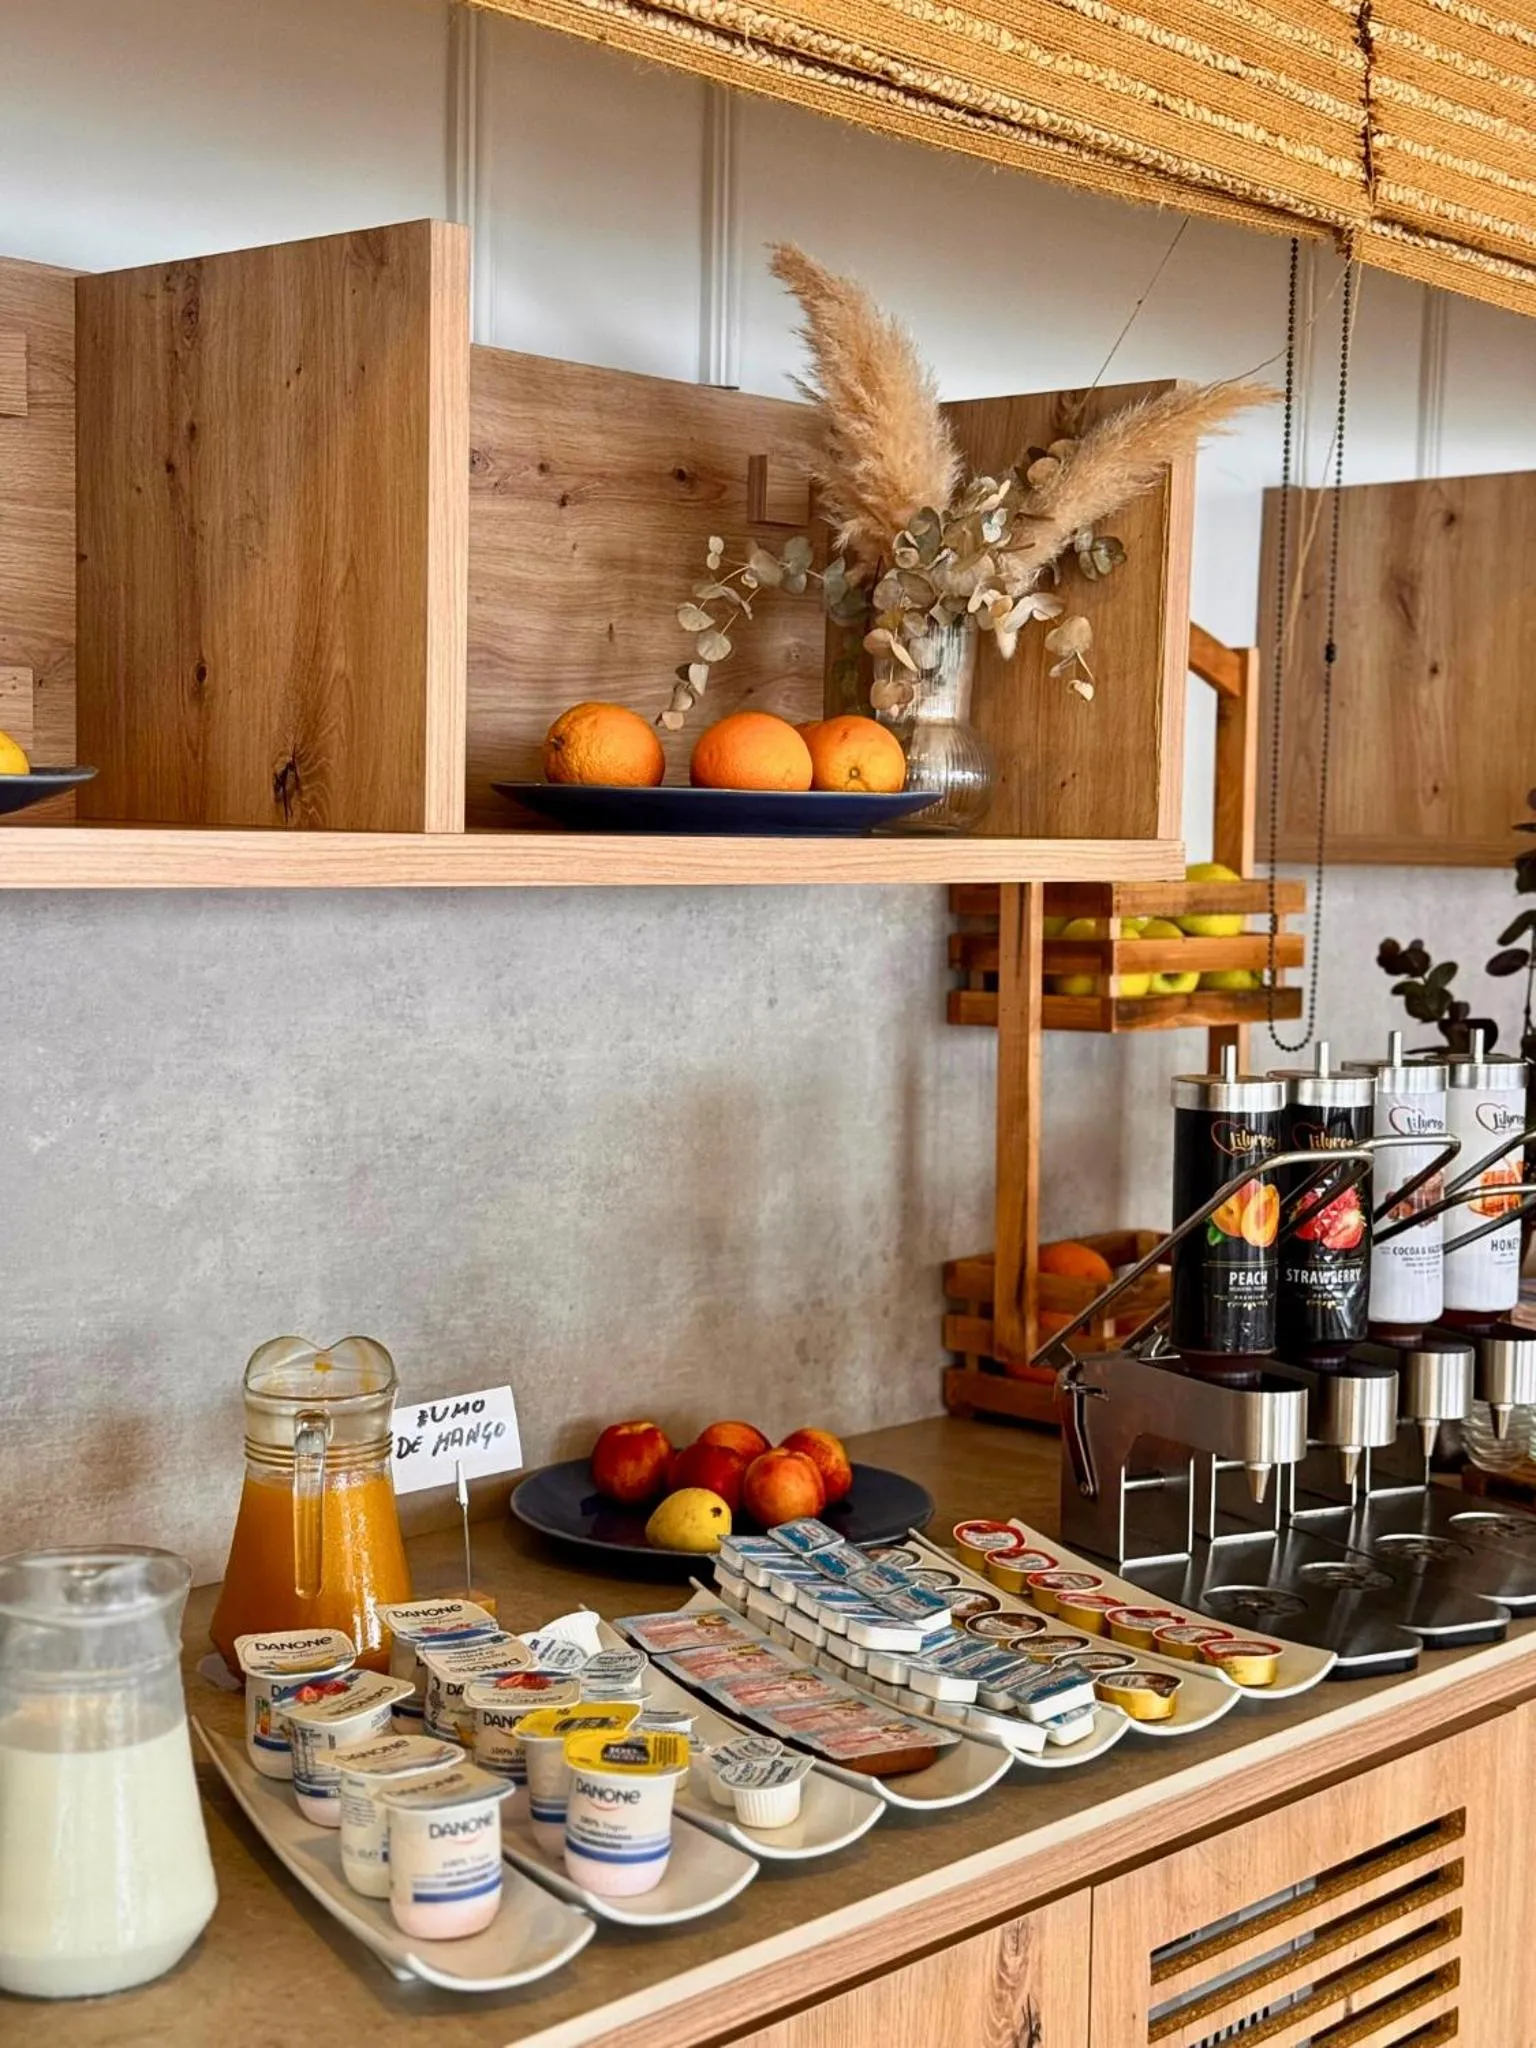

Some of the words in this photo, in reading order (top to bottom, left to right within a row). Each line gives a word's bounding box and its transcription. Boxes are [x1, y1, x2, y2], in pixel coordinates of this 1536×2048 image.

[1228, 1270, 1268, 1286] PEACH
[1285, 1267, 1362, 1285] STRAWBERRY
[396, 1435, 424, 1460] DE
[432, 1421, 507, 1457] MANGO
[392, 1603, 464, 1619] DANONE
[254, 1636, 333, 1651] DANONE
[575, 1777, 641, 1805] DANONE
[428, 1810, 495, 1839] DANONE
